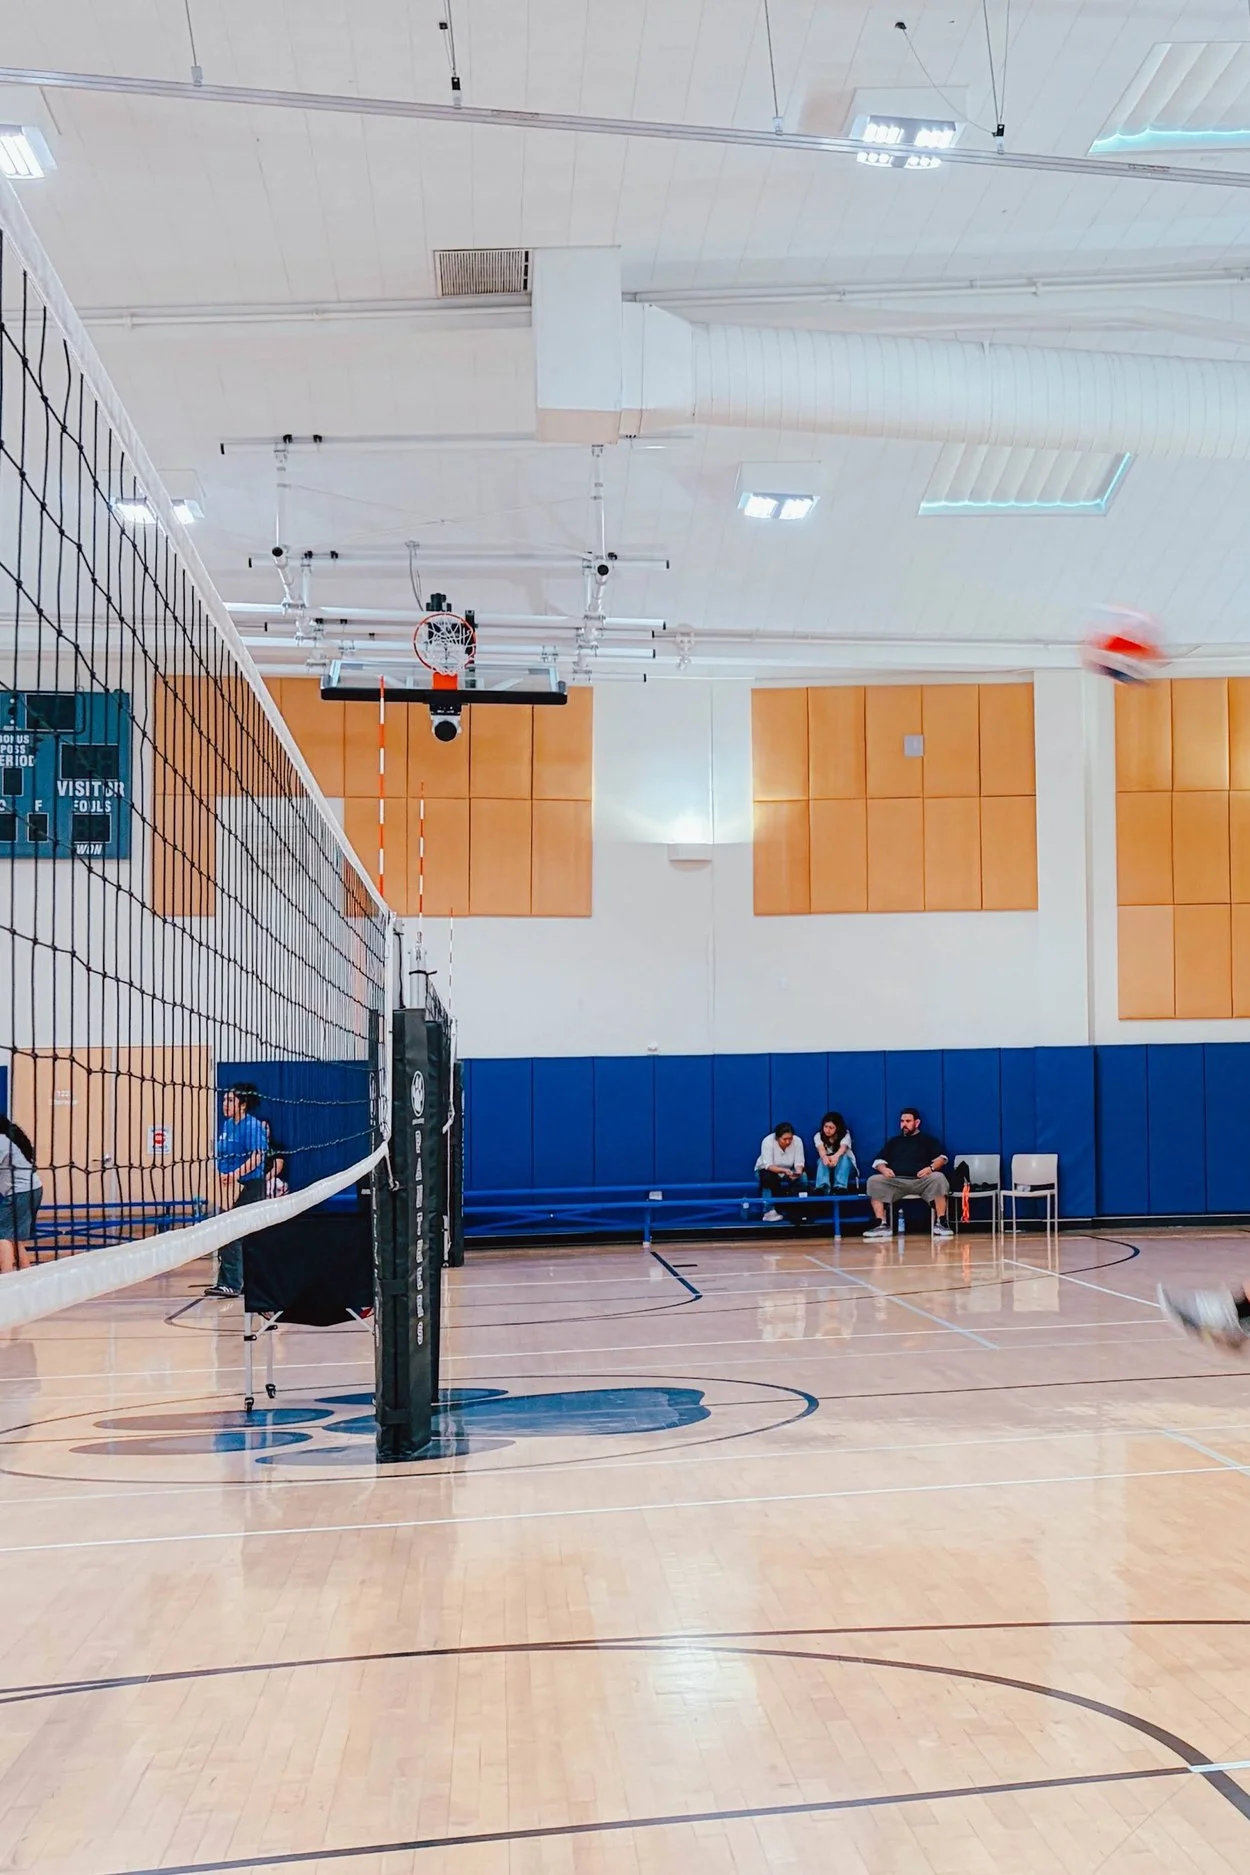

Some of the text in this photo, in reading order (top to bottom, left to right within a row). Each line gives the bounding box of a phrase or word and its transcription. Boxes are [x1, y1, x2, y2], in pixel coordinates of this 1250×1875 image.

[0, 755, 35, 767] ERIOD
[57, 780, 125, 797] VISITOR
[76, 844, 103, 856] WON
